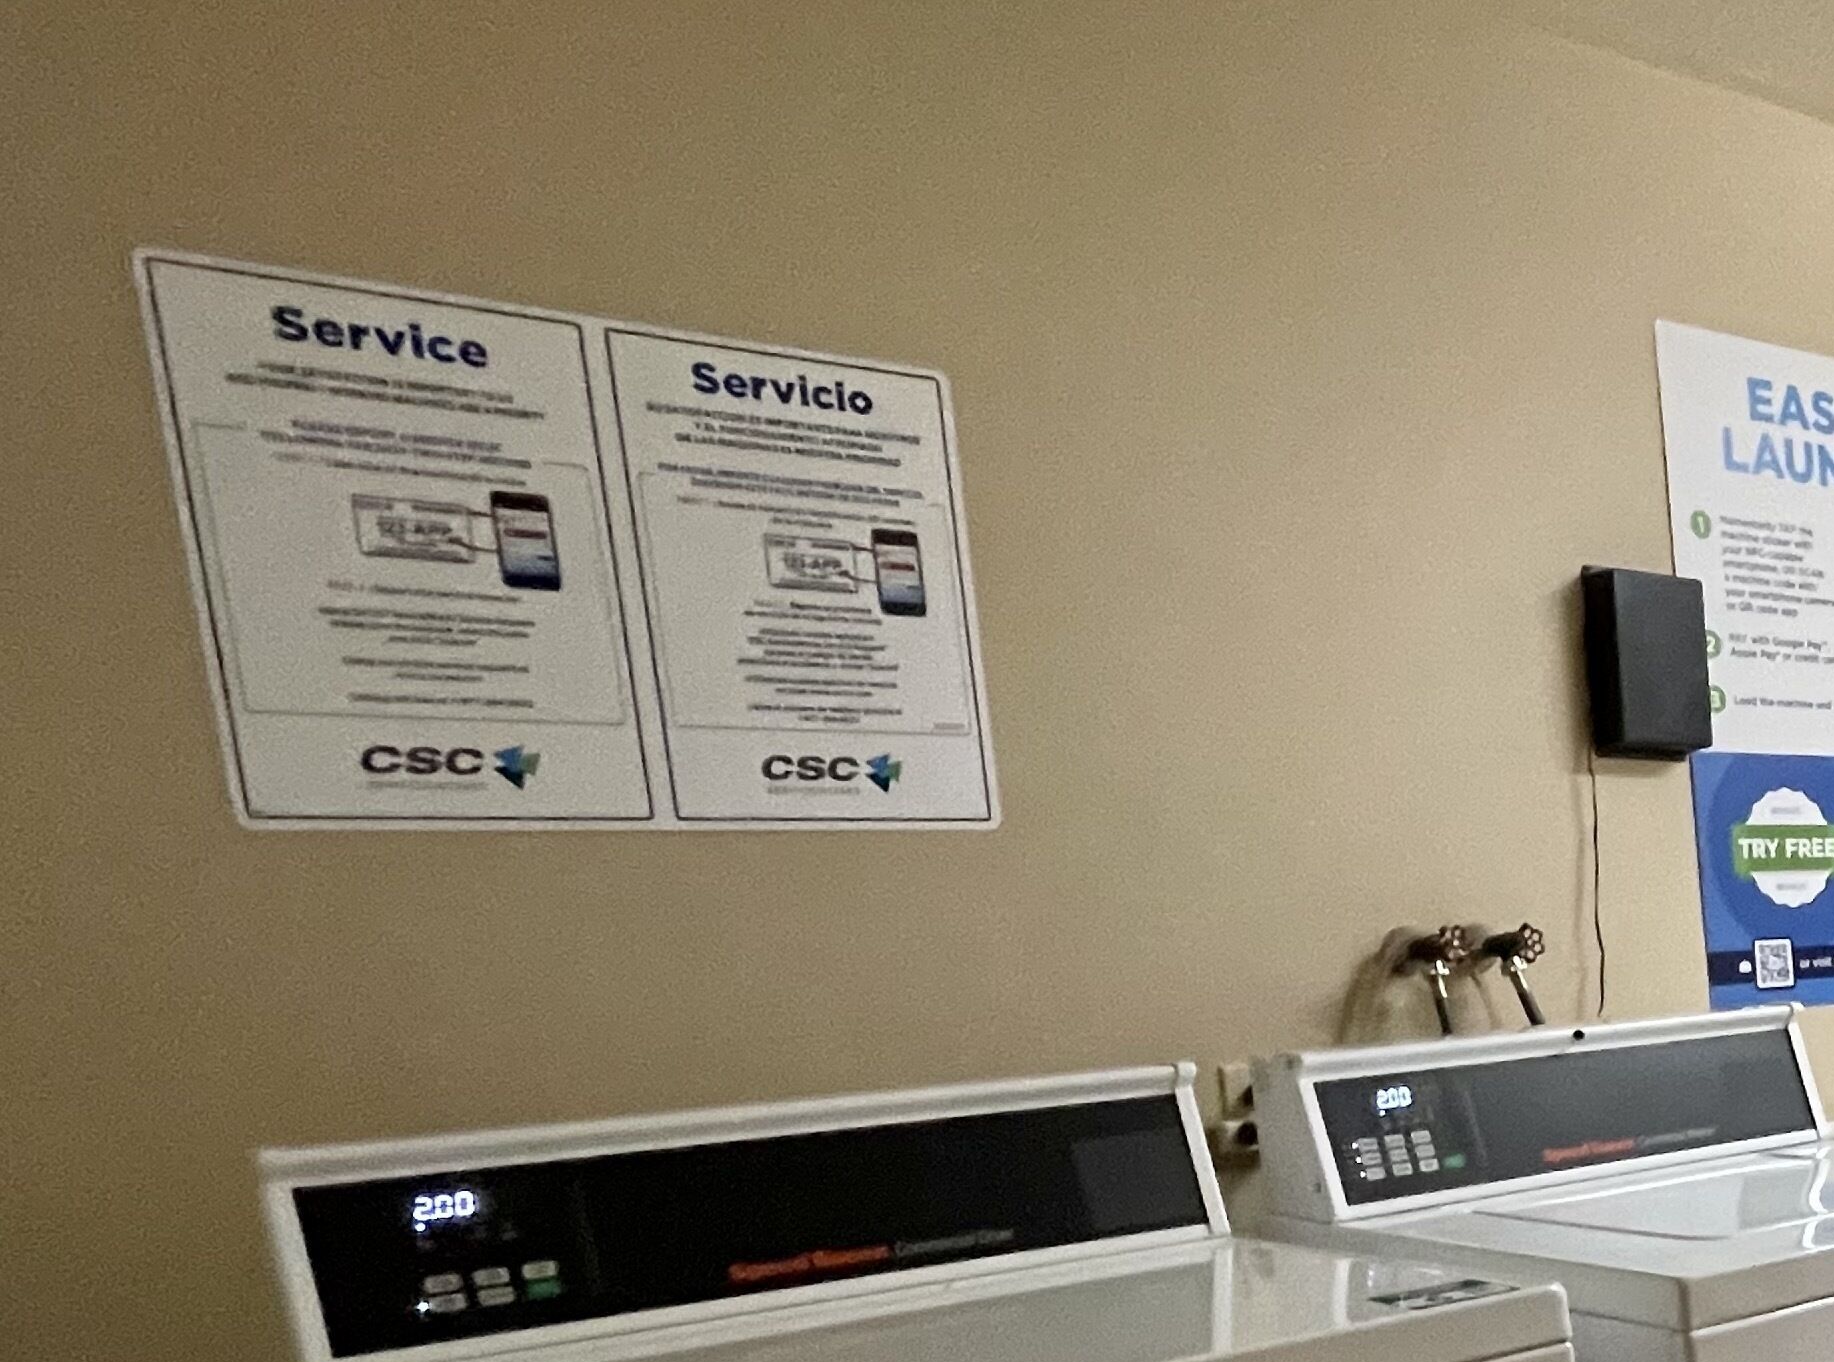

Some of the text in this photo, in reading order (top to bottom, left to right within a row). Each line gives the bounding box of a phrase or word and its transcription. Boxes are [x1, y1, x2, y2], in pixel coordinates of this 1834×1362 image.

[271, 305, 490, 369] Service
[691, 361, 873, 416] Servicio
[361, 744, 484, 777] CSC
[762, 753, 859, 782] CSC
[1737, 838, 1779, 859] TRY
